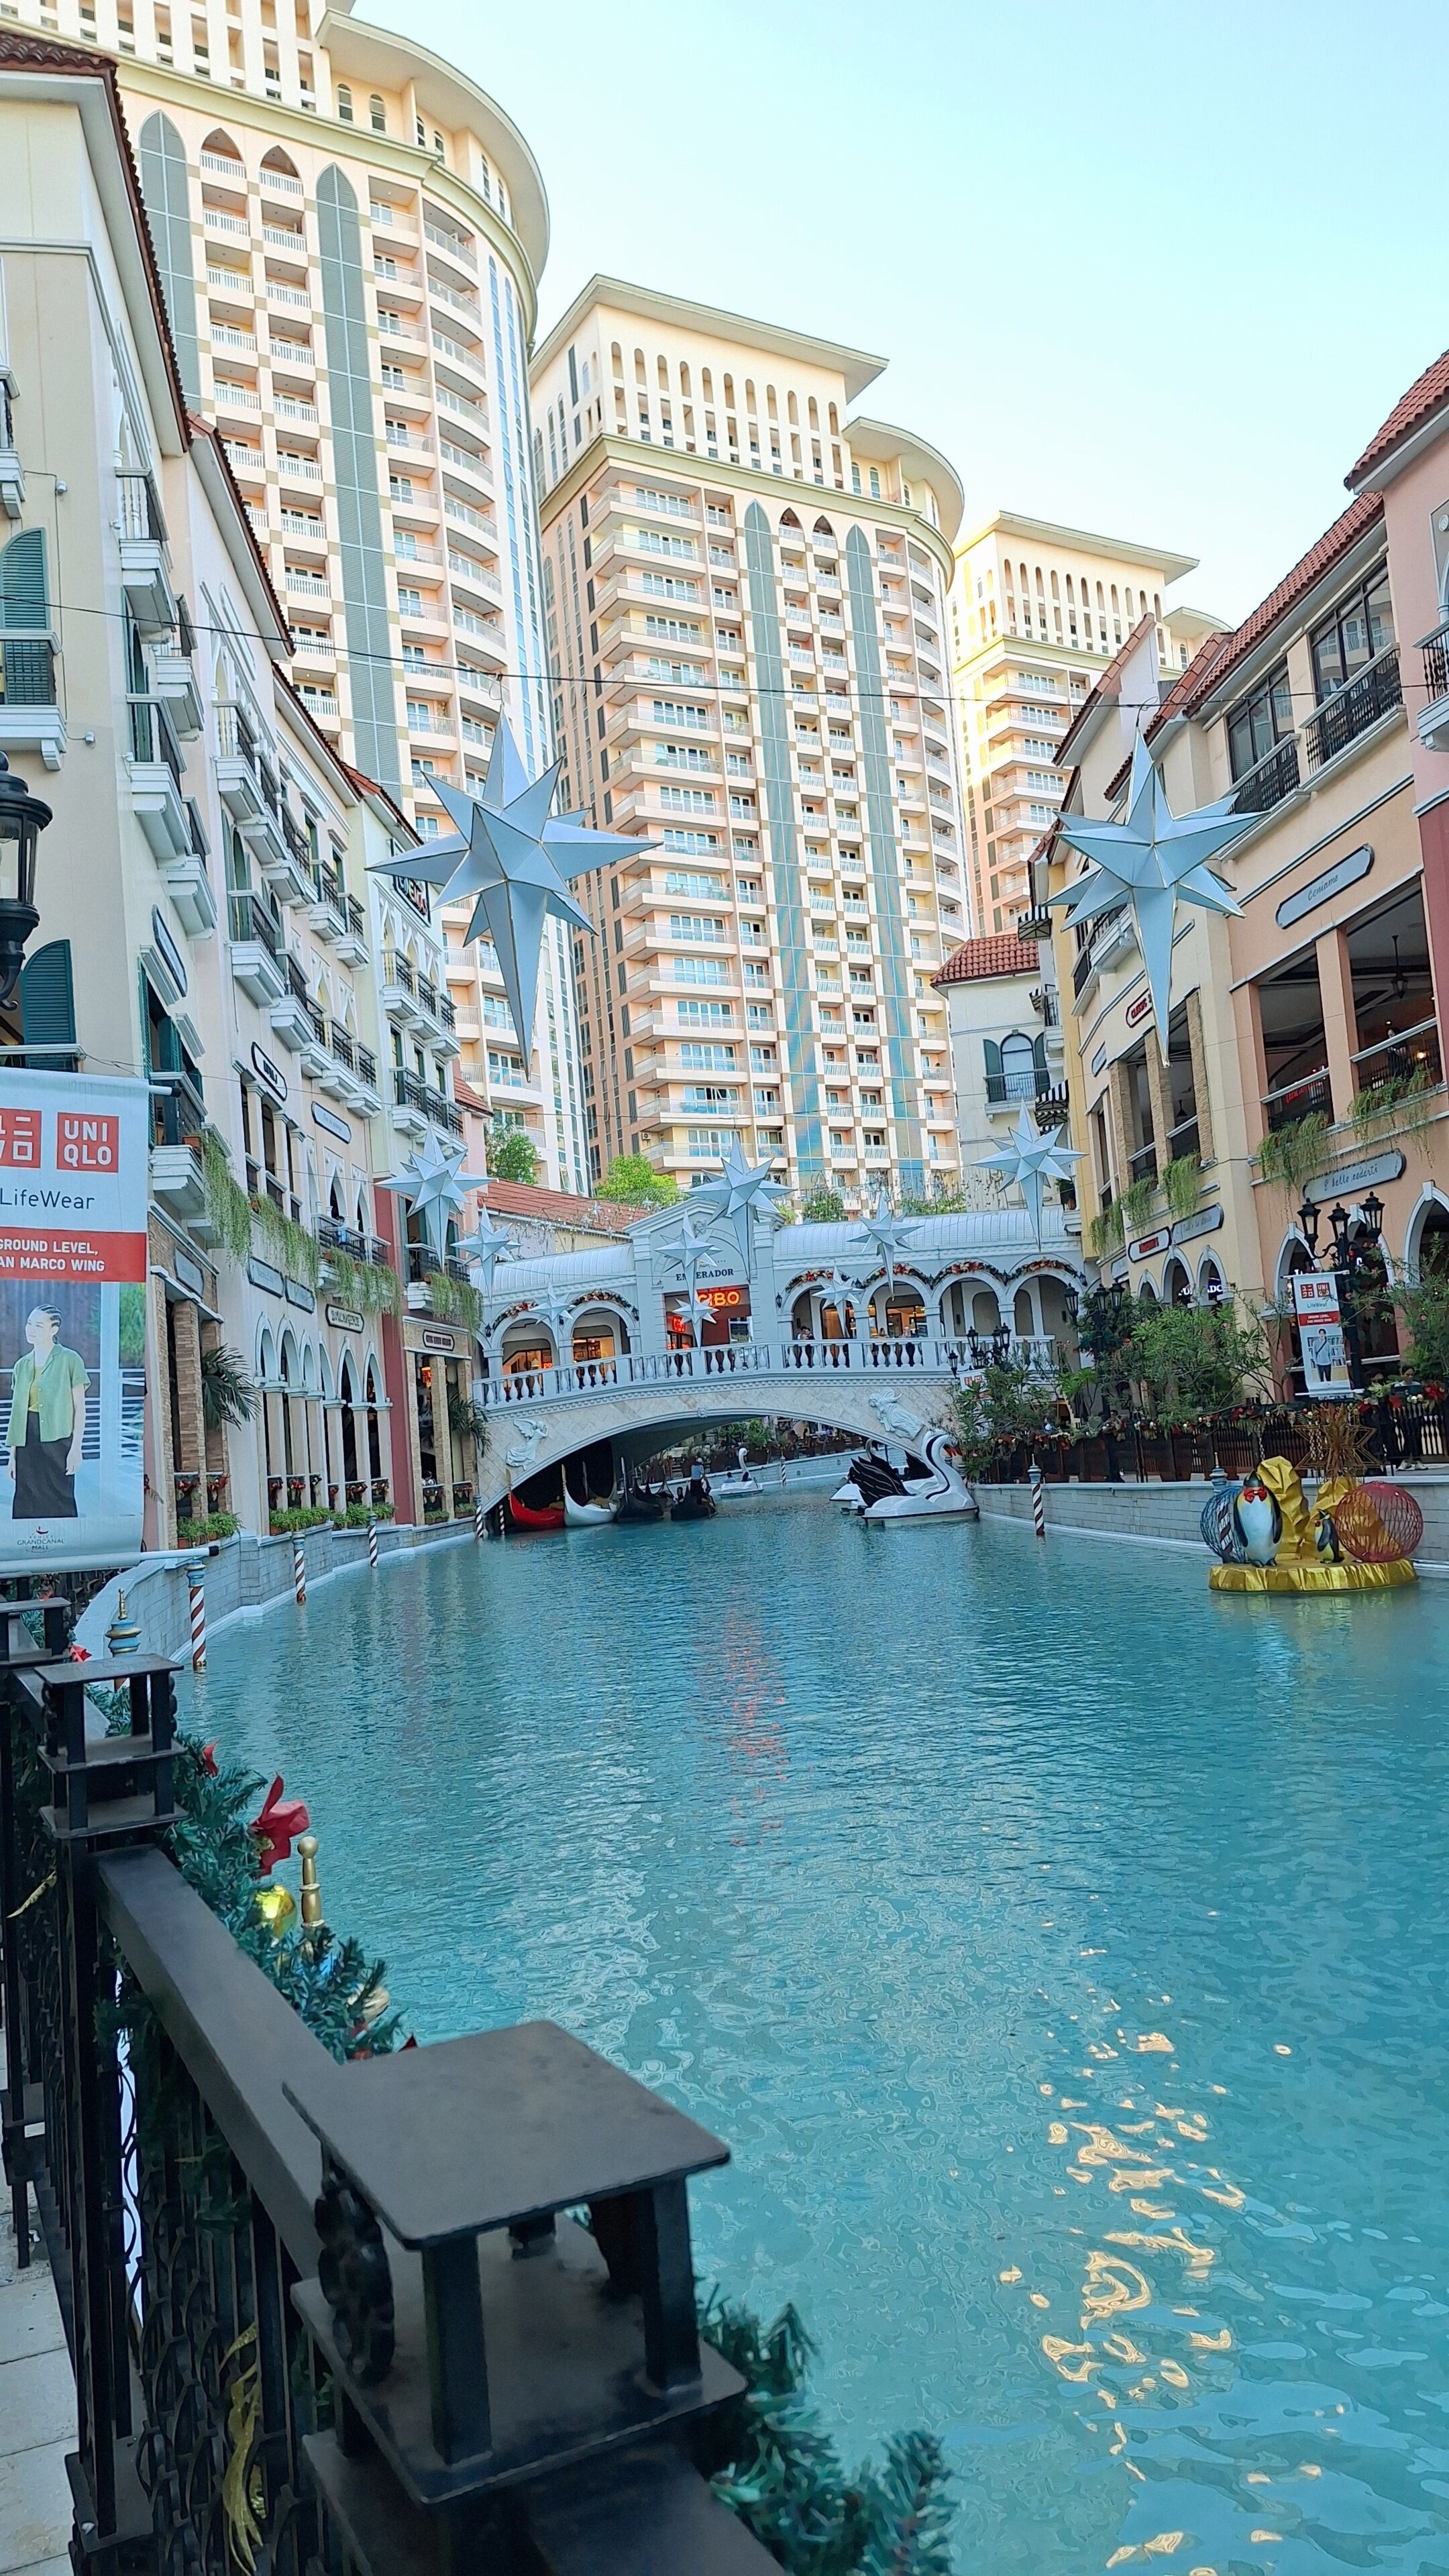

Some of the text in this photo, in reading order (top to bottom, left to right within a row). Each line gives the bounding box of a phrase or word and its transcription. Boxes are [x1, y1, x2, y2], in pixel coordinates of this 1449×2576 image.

[64, 1120, 108, 1142] UNI
[64, 1143, 112, 1167] QLO
[0, 1187, 95, 1210] LifeWear
[53, 1241, 99, 1256] LEVEL,
[20, 1257, 66, 1271] MARCO
[71, 1259, 105, 1272] WING
[676, 1269, 735, 1281] EERADOR
